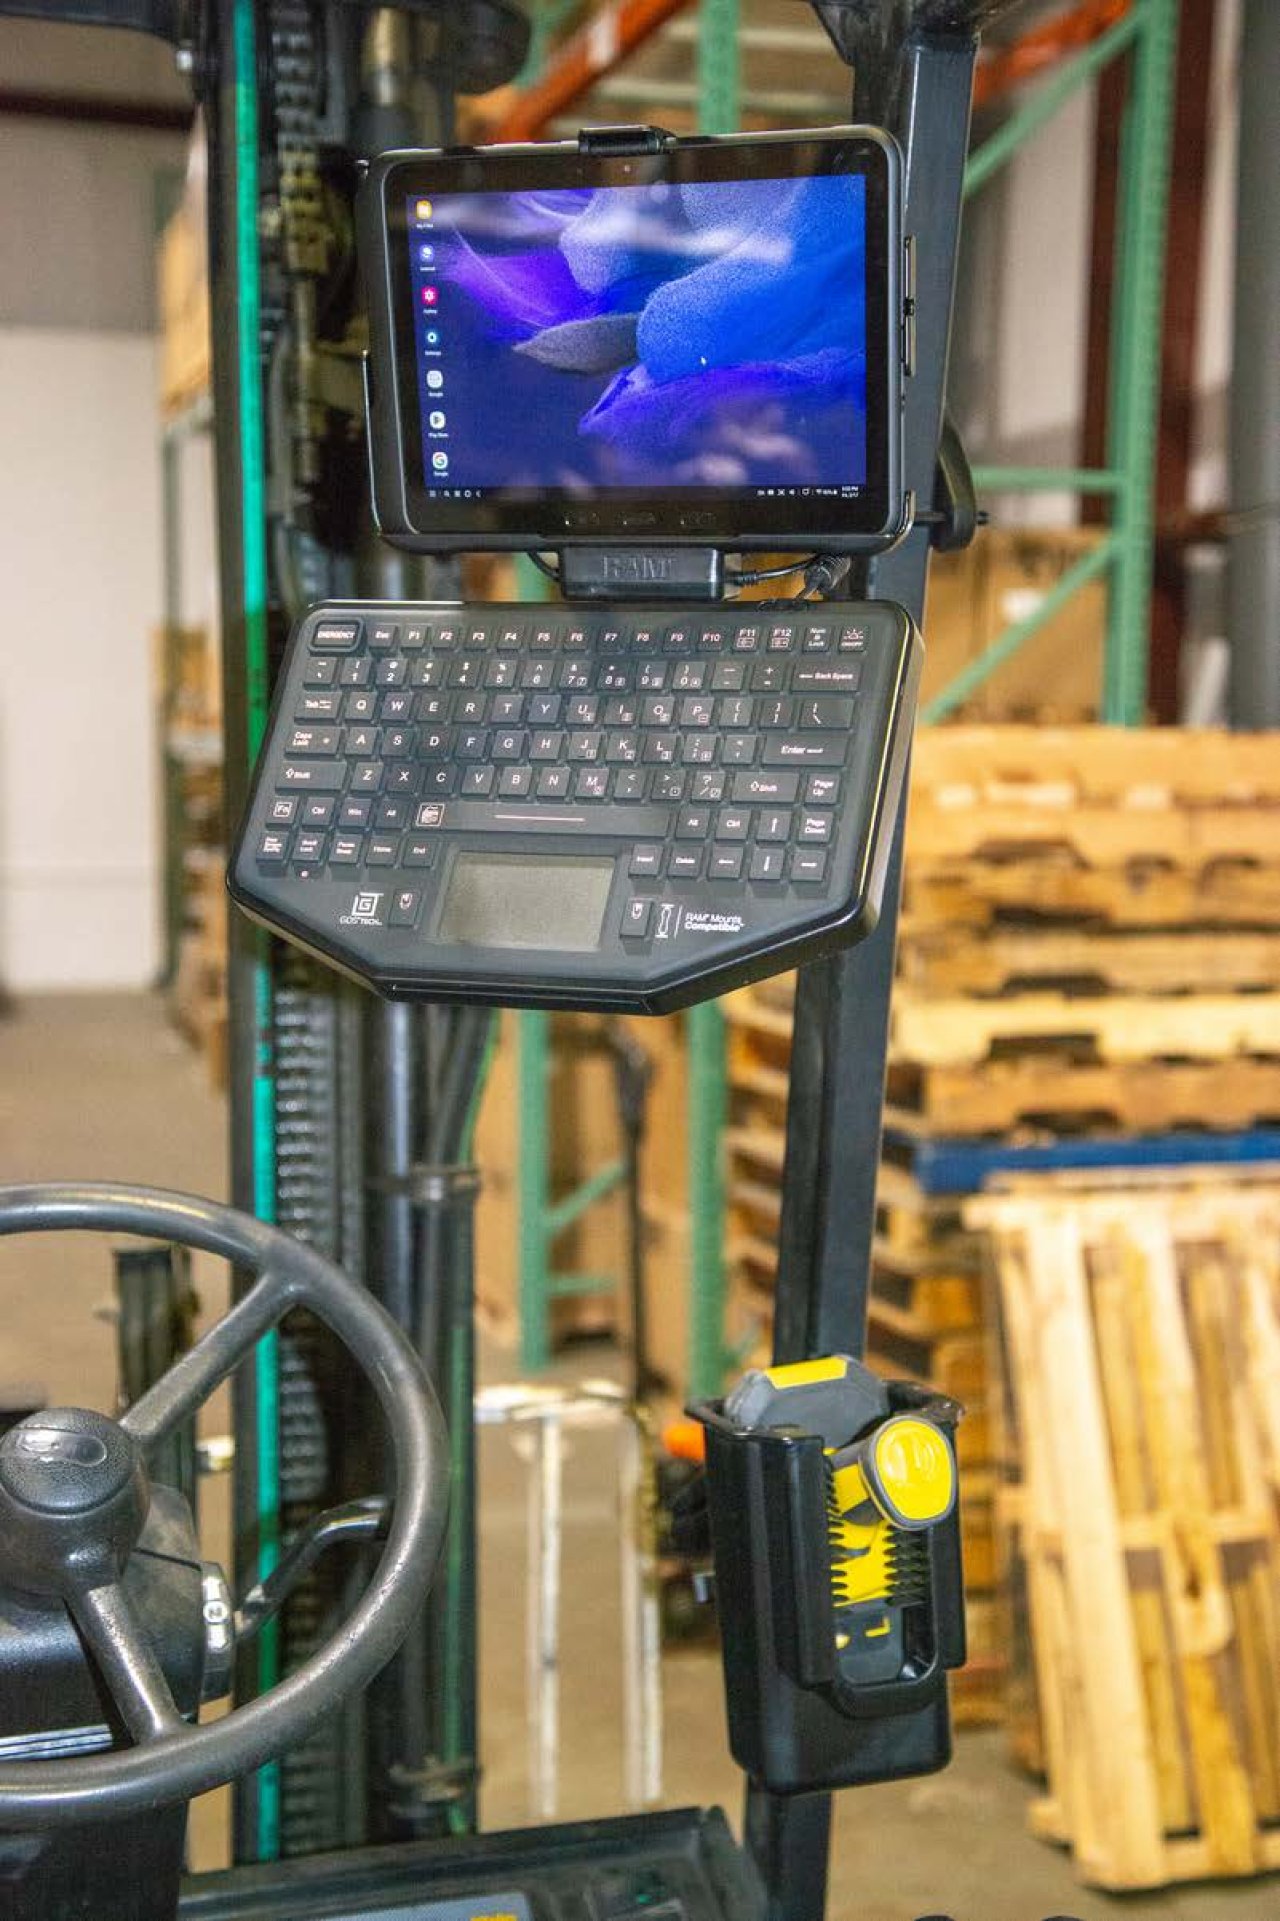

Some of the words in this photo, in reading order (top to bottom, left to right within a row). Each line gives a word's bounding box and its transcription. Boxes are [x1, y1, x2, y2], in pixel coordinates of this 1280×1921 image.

[408, 630, 420, 640] F1
[440, 631, 453, 640] F2
[472, 632, 485, 640] F3
[504, 632, 517, 640] F4
[537, 632, 551, 642] F5
[571, 632, 584, 642] F6
[604, 632, 618, 642] F7
[636, 633, 650, 642] F8
[670, 632, 684, 642] F9
[702, 633, 721, 642] F10
[739, 628, 756, 636] F11
[773, 628, 792, 637] F12
[351, 672, 359, 682] 1
[386, 672, 396, 682] 2
[421, 673, 431, 684] 3
[458, 674, 467, 684] 4
[496, 673, 504, 684] 5
[532, 674, 541, 685] 6
[568, 675, 576, 685] 7
[605, 675, 613, 685] 8
[641, 675, 650, 685] 9
[680, 675, 688, 686] 0
[356, 700, 367, 711] Q
[391, 701, 404, 712] W
[429, 701, 439, 712] E
[465, 702, 476, 712] R
[504, 703, 512, 714] T
[541, 704, 551, 714] Y
[577, 704, 588, 715] U
[653, 705, 664, 715] O
[692, 705, 703, 716] P
[355, 734, 367, 745] A
[393, 734, 403, 746] S
[429, 736, 440, 746] D
[466, 737, 476, 747] F
[504, 738, 514, 749] G
[541, 738, 552, 749] H
[580, 739, 589, 749] J
[619, 739, 629, 750] K
[656, 741, 664, 751] L
[781, 745, 806, 755] Enter
[362, 769, 374, 781] Z
[399, 771, 410, 782] X
[436, 772, 447, 783] C
[475, 773, 484, 784] V
[512, 774, 521, 784] B
[549, 774, 560, 786] N
[586, 776, 599, 786] M
